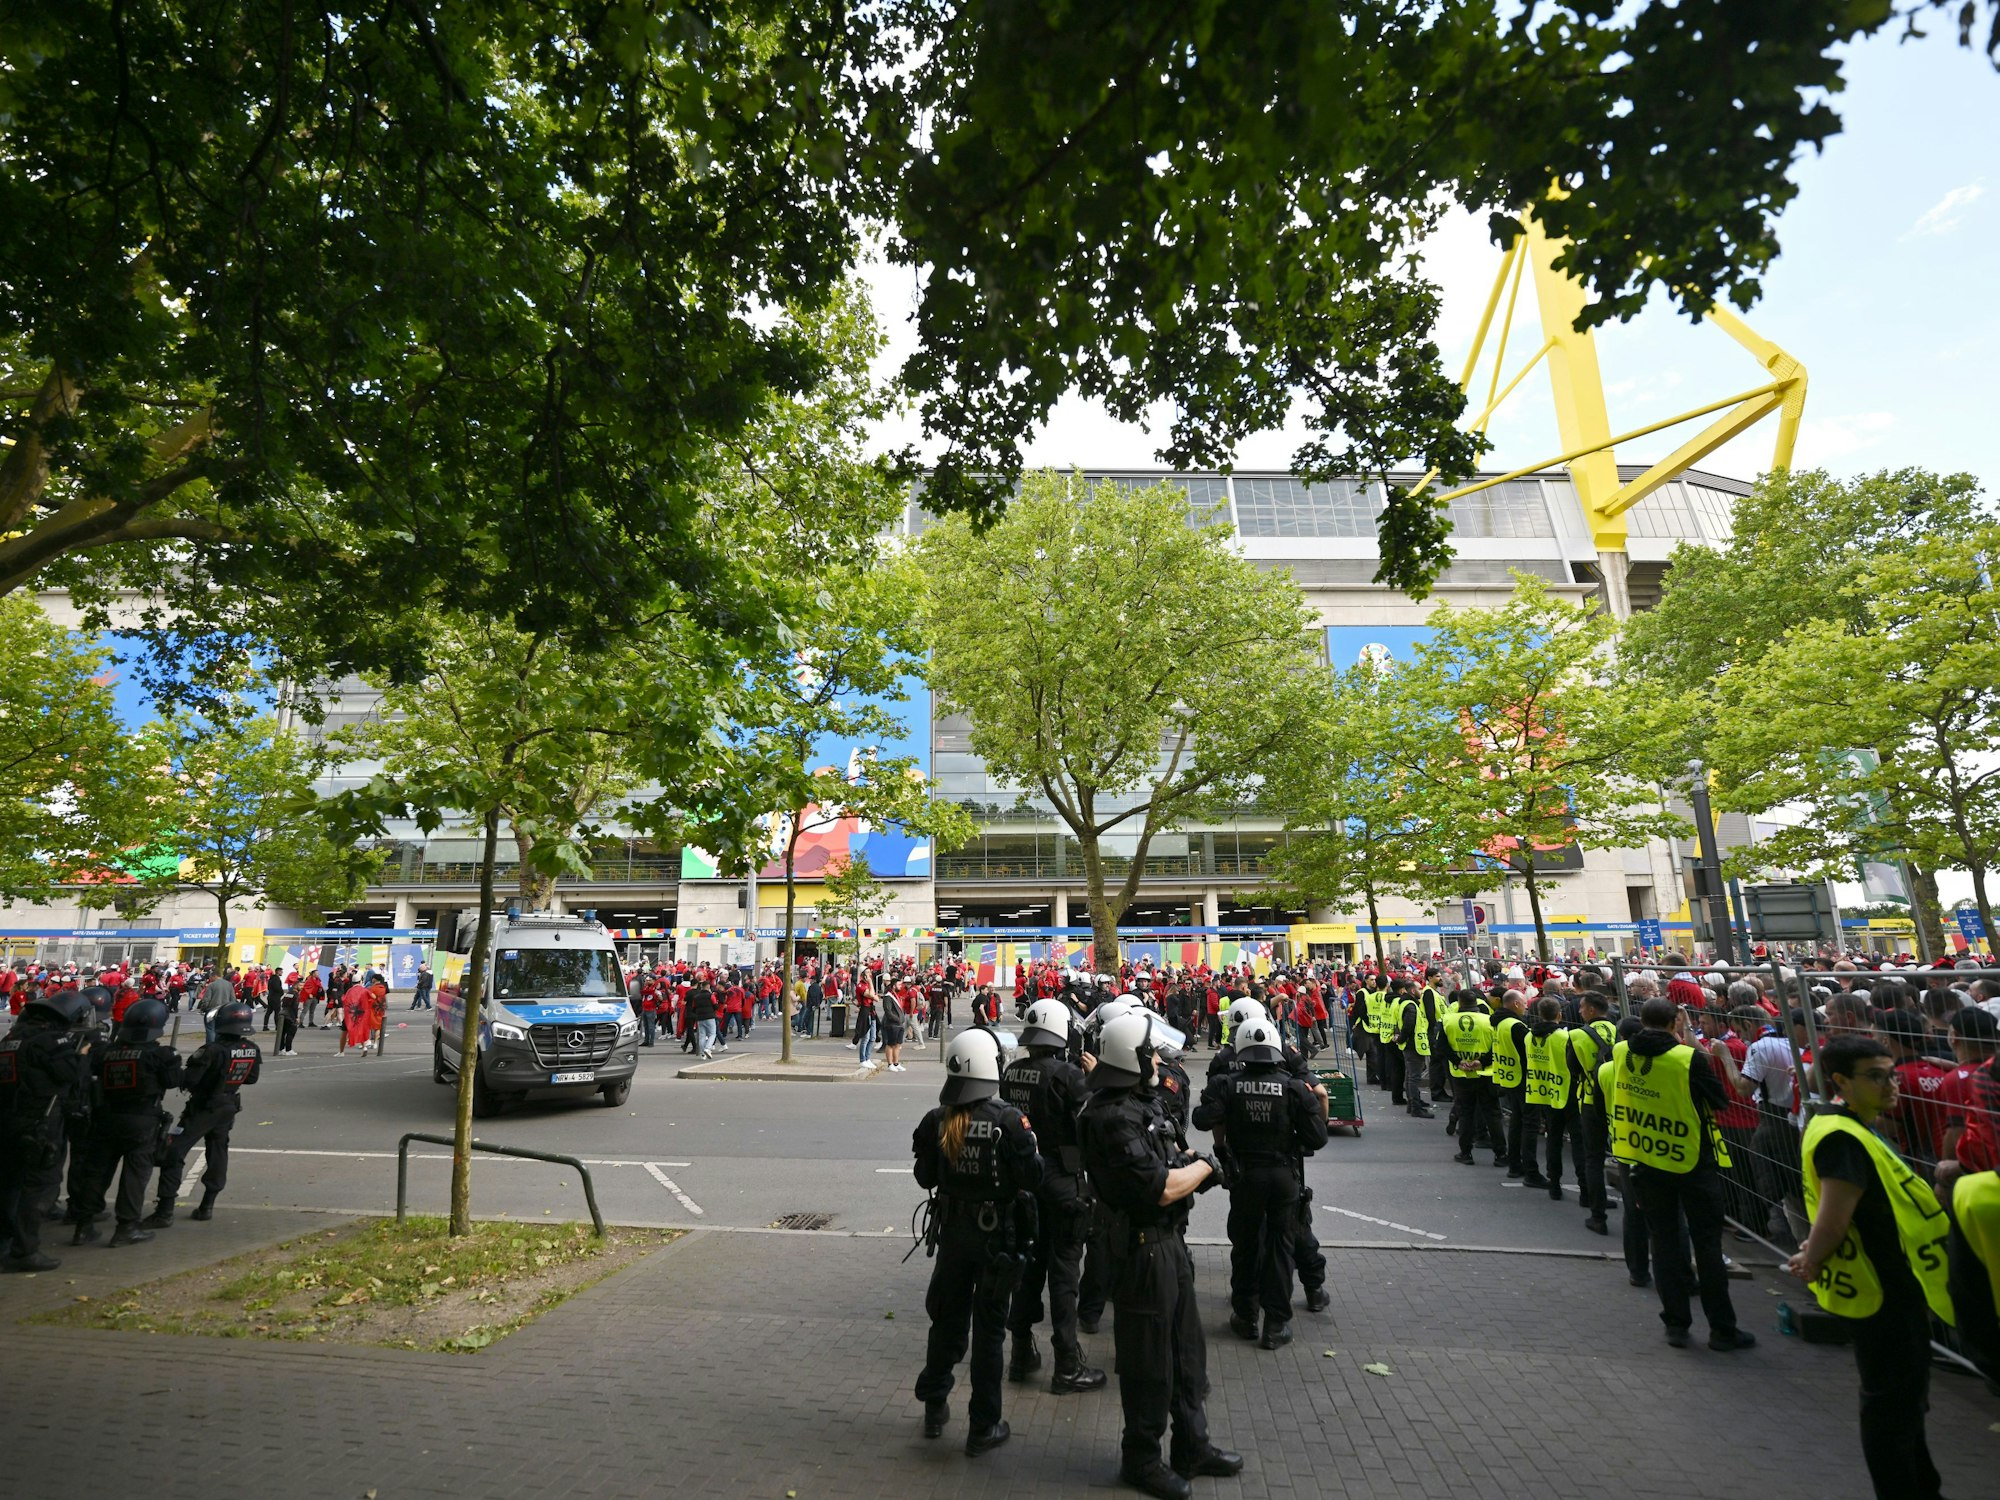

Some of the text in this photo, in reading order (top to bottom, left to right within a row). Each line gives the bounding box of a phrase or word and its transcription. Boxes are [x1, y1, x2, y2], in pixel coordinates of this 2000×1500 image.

[1042, 1012, 1048, 1024] 1
[1245, 1029, 1253, 1041] 4
[104, 1049, 142, 1060] POLIZEI
[965, 1057, 971, 1073] 1
[556, 1072, 594, 1081] NRW 4 5829
[1004, 1069, 1041, 1085] POLIZEI
[1009, 1088, 1031, 1101] NRW
[1236, 1081, 1283, 1097] POLIZEI
[1616, 1081, 1661, 1099] EURO2024
[1245, 1100, 1272, 1112] NRW
[1249, 1111, 1271, 1123] 1411
[955, 1161, 980, 1175] 1413
